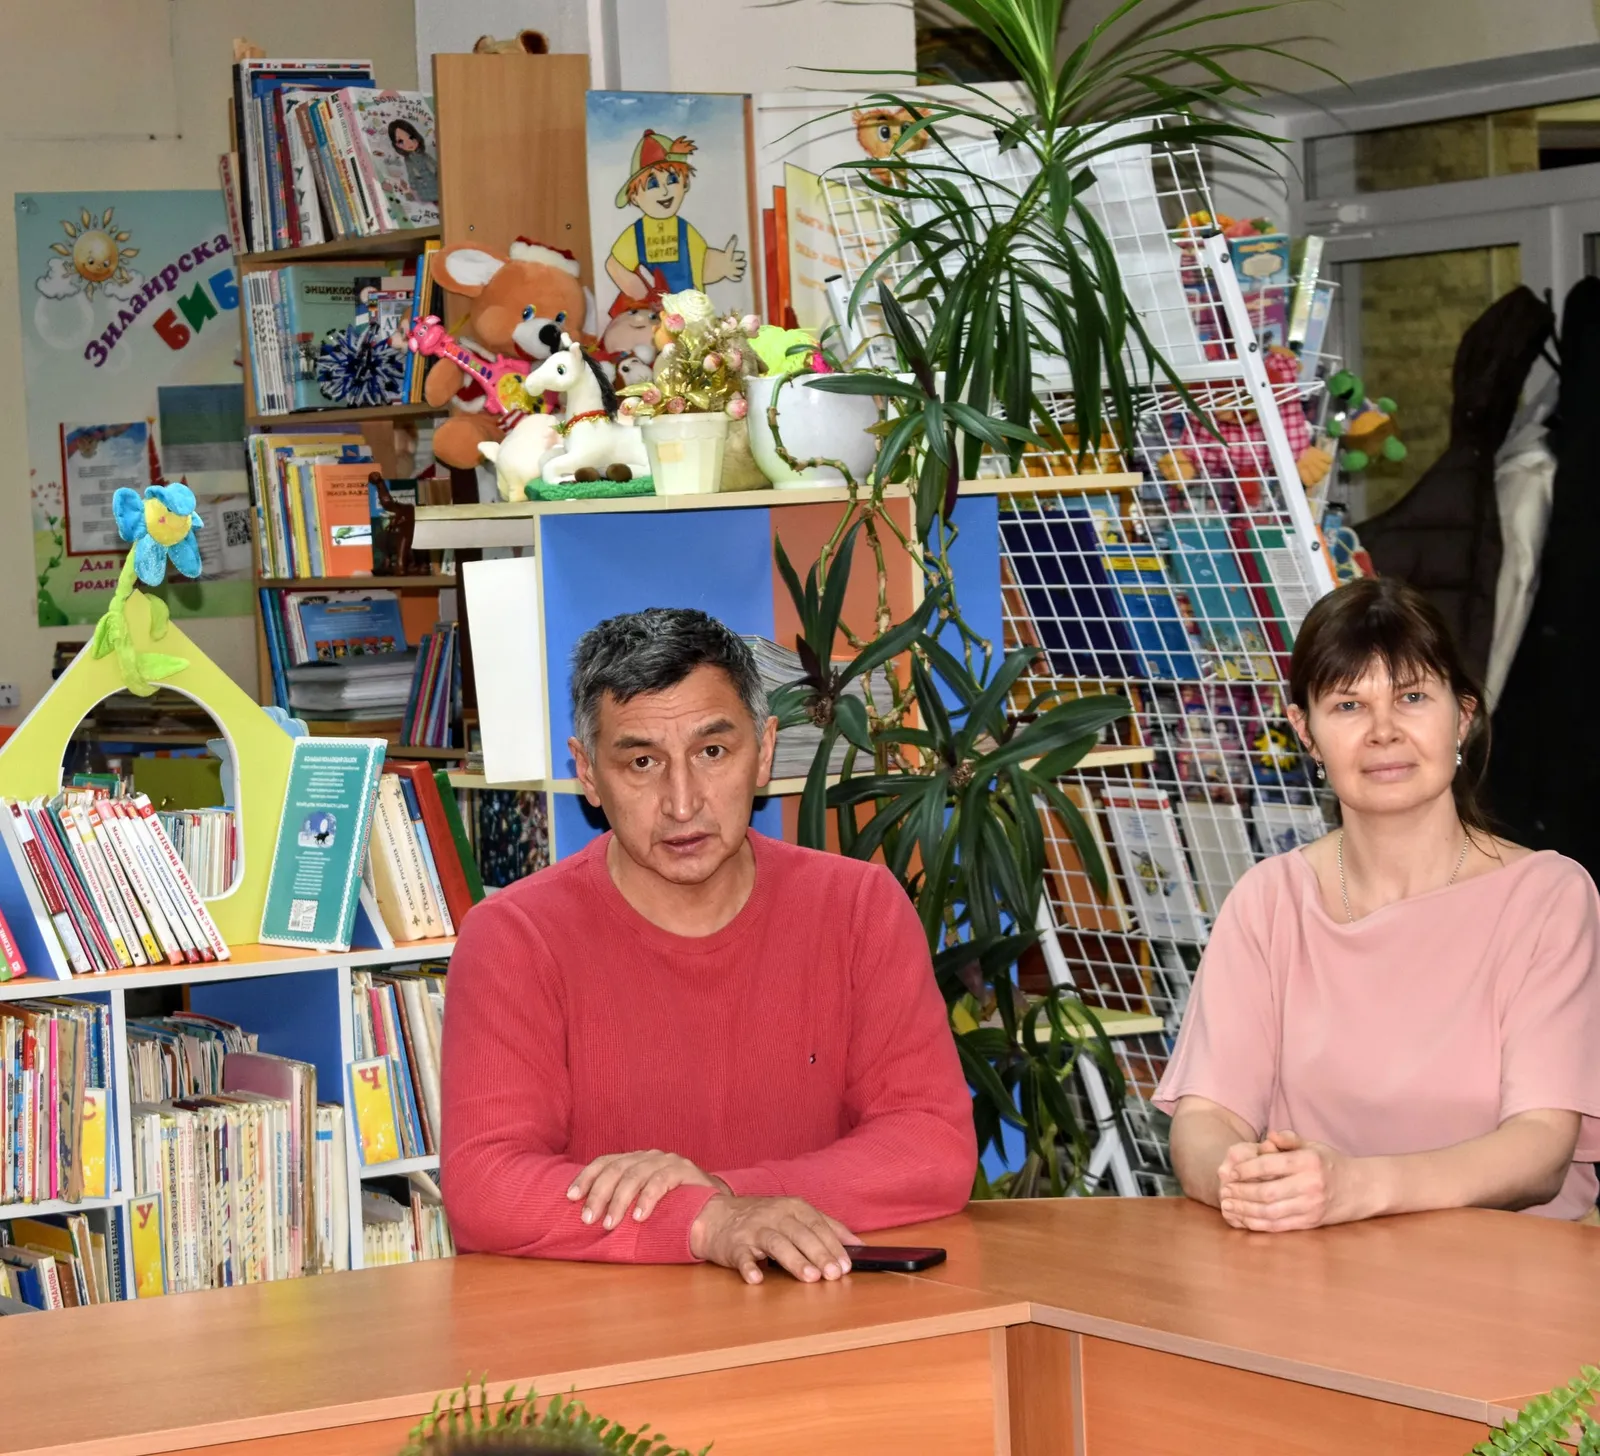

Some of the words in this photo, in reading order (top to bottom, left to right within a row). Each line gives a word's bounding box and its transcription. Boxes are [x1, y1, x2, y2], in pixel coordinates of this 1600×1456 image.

[80, 558, 114, 572] Для
[358, 1066, 381, 1090] Ч
[136, 1202, 153, 1229] У
